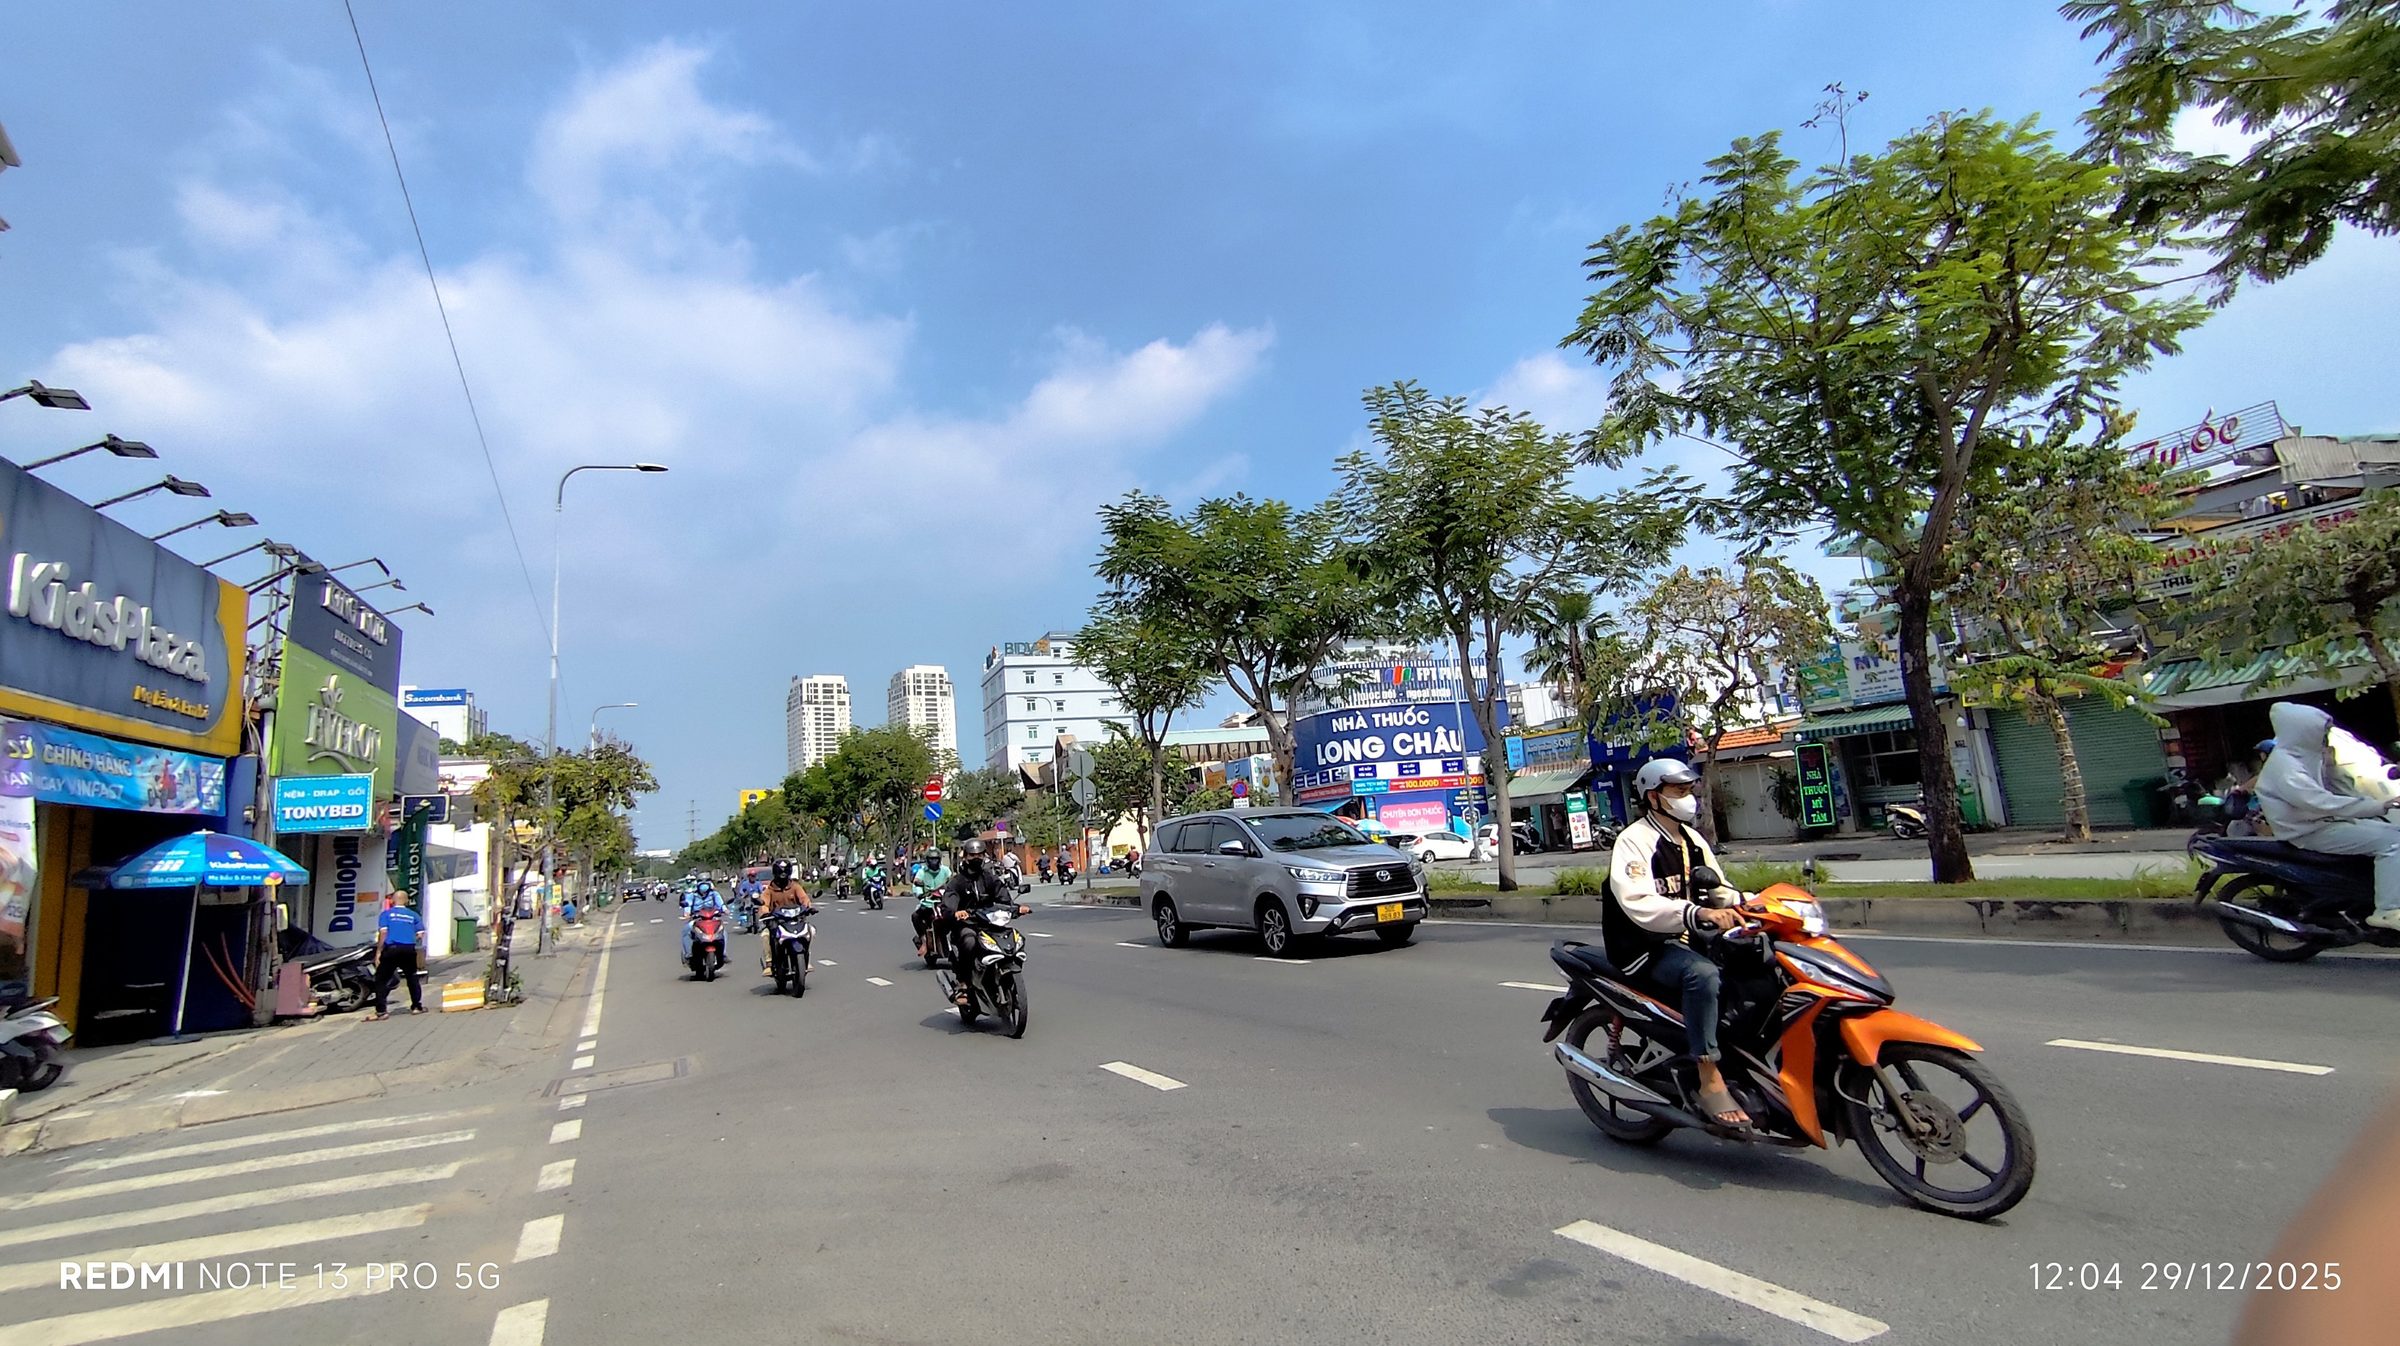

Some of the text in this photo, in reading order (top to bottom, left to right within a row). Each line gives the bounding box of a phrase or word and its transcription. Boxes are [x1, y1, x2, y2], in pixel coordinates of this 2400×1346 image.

[9, 553, 206, 682] KidsPlaza
[1417, 664, 1488, 682] FPT PHAMA
[405, 693, 462, 703] Sacombank
[1332, 705, 1430, 733] NHÀ THUỐC
[304, 703, 382, 764] EVERON
[1316, 725, 1464, 766] LONG CHÂU
[283, 786, 366, 800] NỆM DRAP GỐI
[1803, 781, 1828, 796] THUỐC
[283, 804, 364, 820] TONYBED
[409, 842, 420, 906] EVERON
